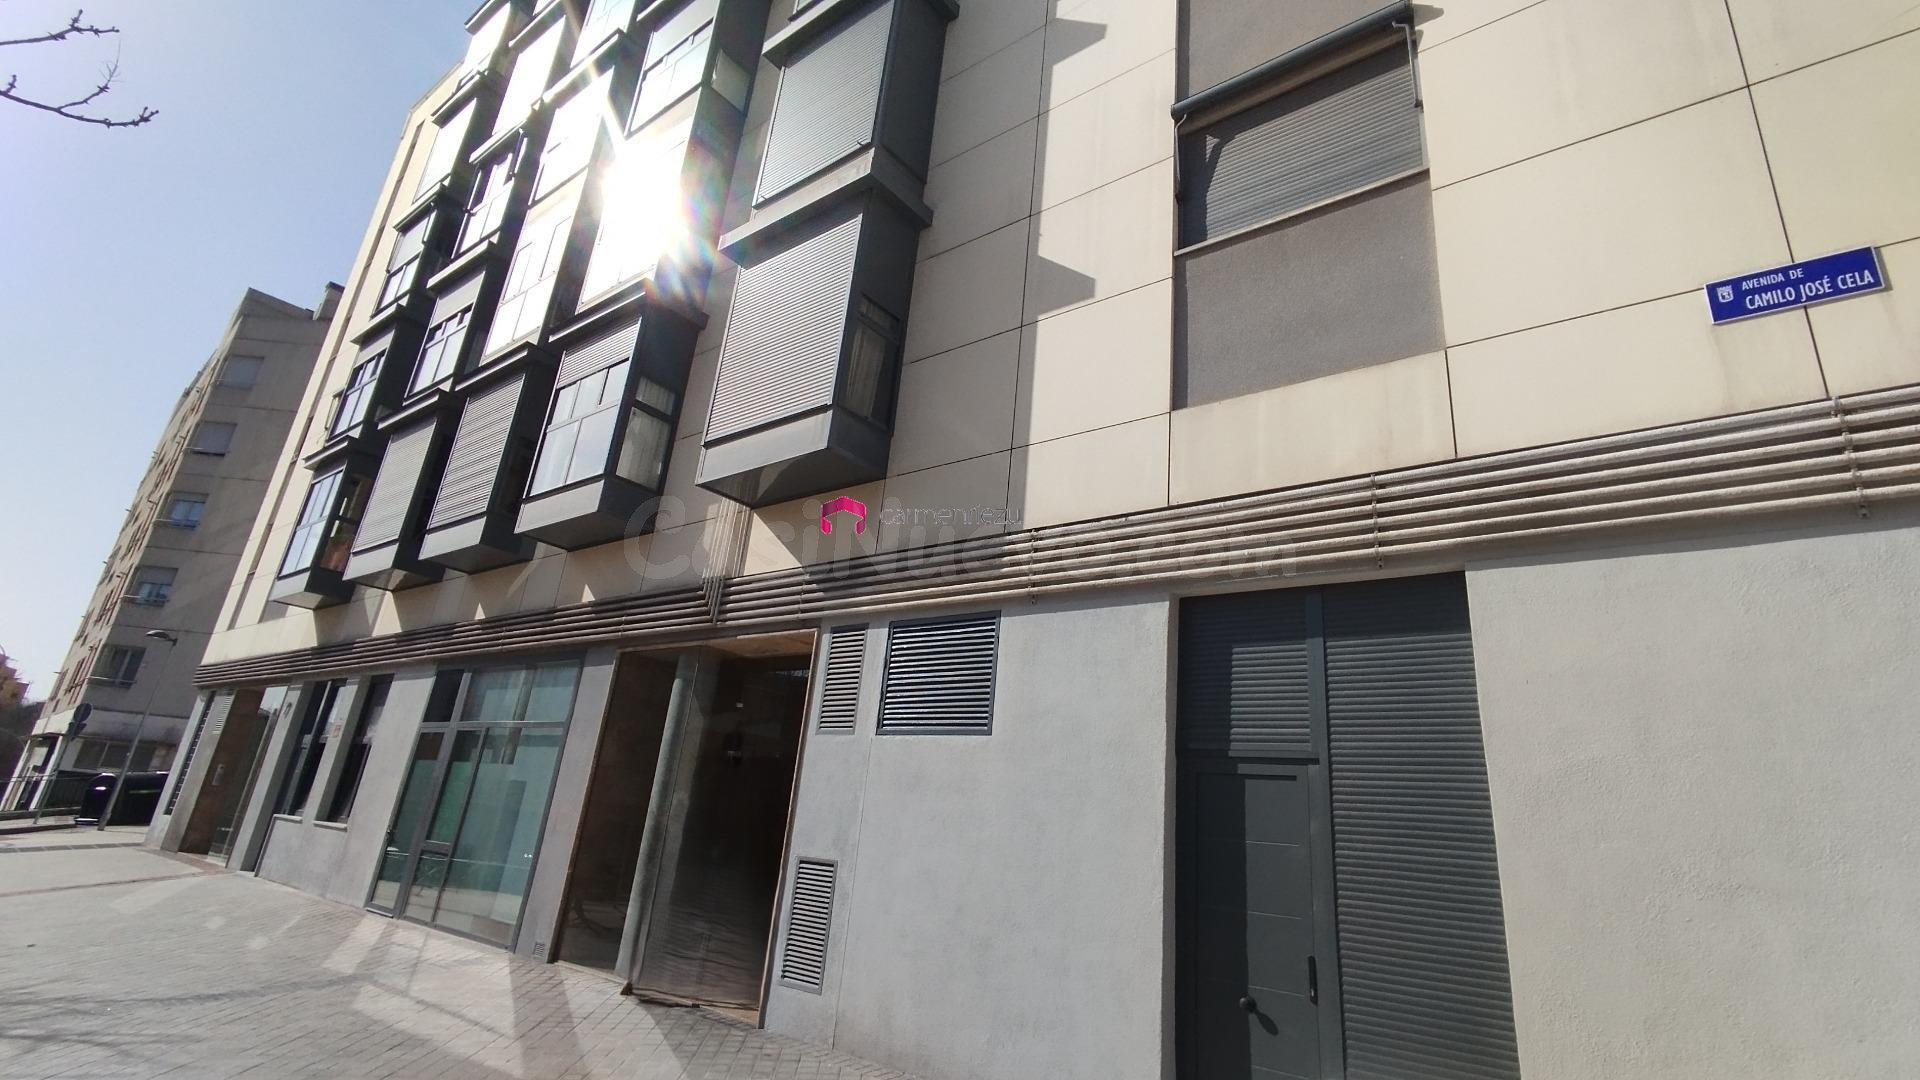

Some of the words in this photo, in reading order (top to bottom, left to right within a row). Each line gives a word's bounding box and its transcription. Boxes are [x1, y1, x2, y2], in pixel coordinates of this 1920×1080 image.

[1742, 273, 1785, 291] AVENIDA
[1789, 268, 1805, 280] DE
[1745, 286, 1796, 309] CAMILO
[1800, 275, 1833, 302] JOSÉ
[1837, 269, 1875, 290] CELA
